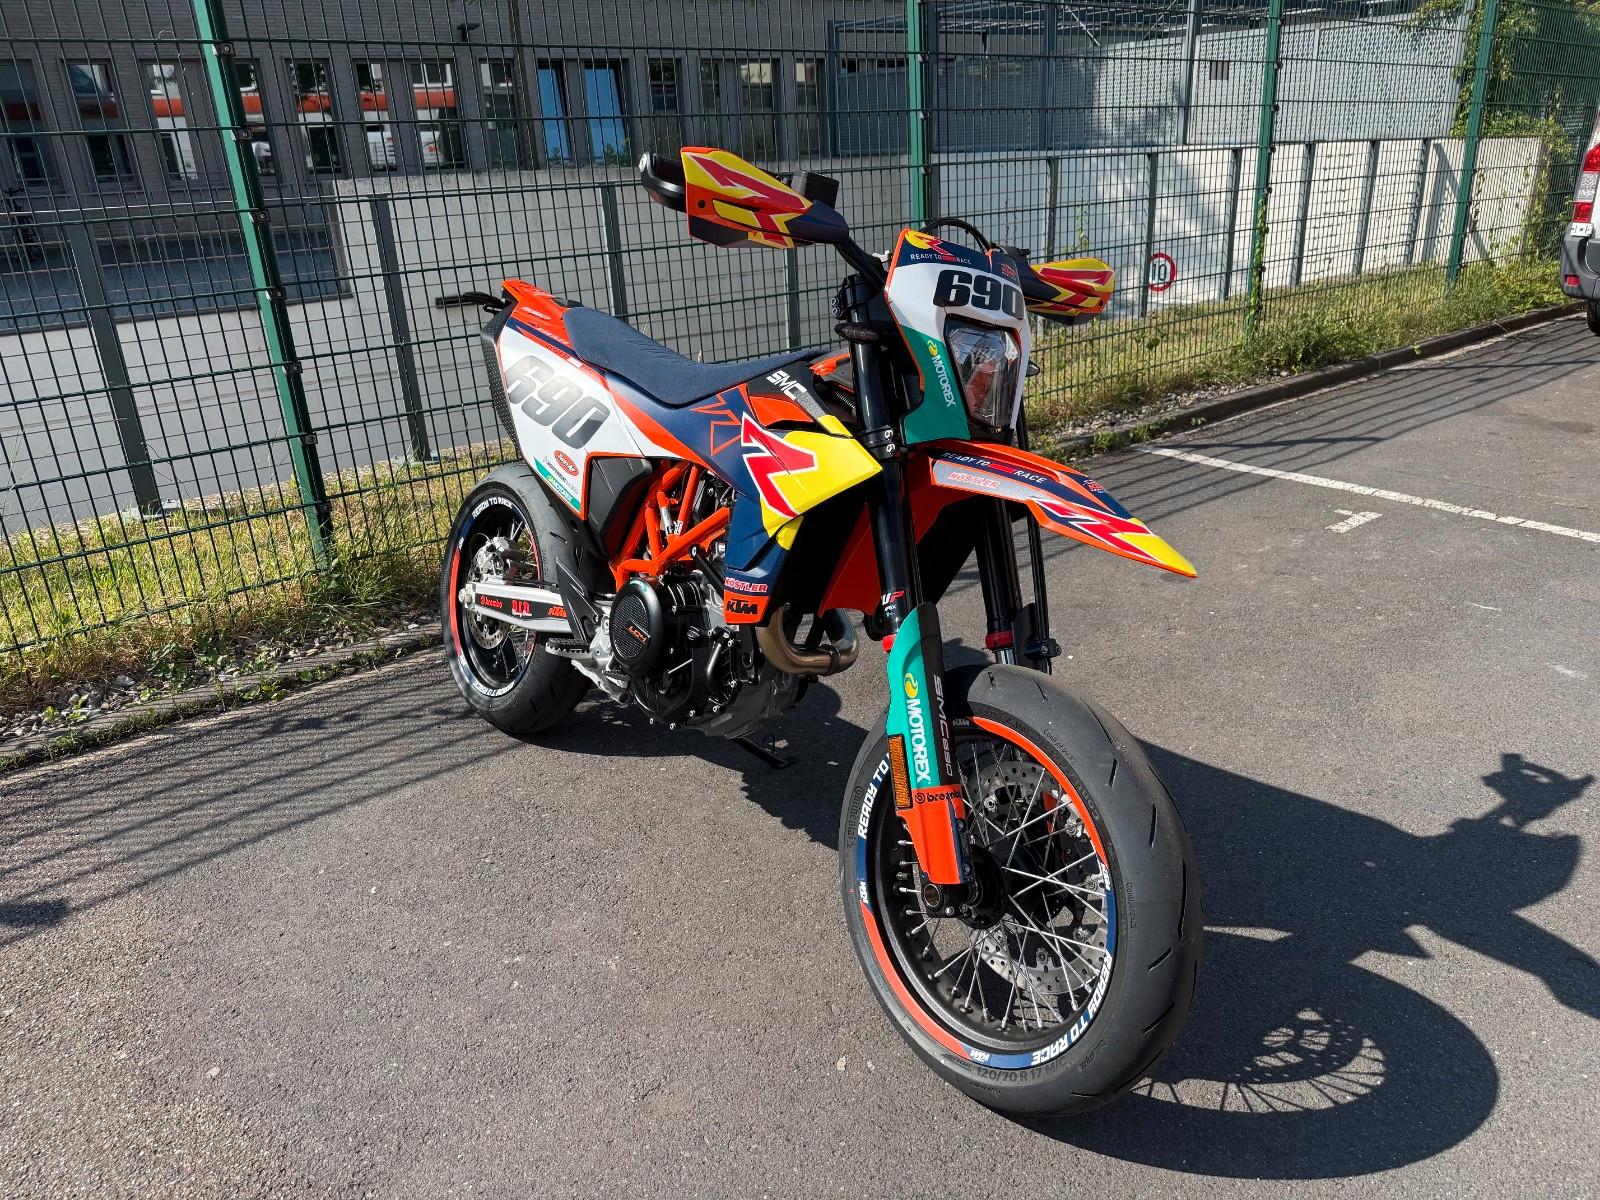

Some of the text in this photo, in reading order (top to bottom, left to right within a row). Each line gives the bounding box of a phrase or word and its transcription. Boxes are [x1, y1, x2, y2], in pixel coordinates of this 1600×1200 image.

[1151, 263, 1167, 281] 10
[932, 269, 1025, 320] 690
[766, 370, 807, 401] SMC
[931, 354, 957, 408] MOTOREX
[503, 354, 611, 450] 690
[942, 452, 1047, 484] READY TO RACE
[471, 499, 490, 520] READY
[488, 497, 498, 506] TO
[726, 598, 758, 615] KTM
[952, 719, 970, 727] KTM
[906, 698, 932, 785] MOTOREX
[857, 759, 890, 840] READY TO
[1087, 950, 1113, 1020] READY
[1070, 1015, 1089, 1044] TO
[1030, 1032, 1069, 1066] RACE
[976, 1066, 1018, 1082] 120/70
[1019, 1071, 1028, 1082] R
[1030, 1069, 1042, 1081] 17
